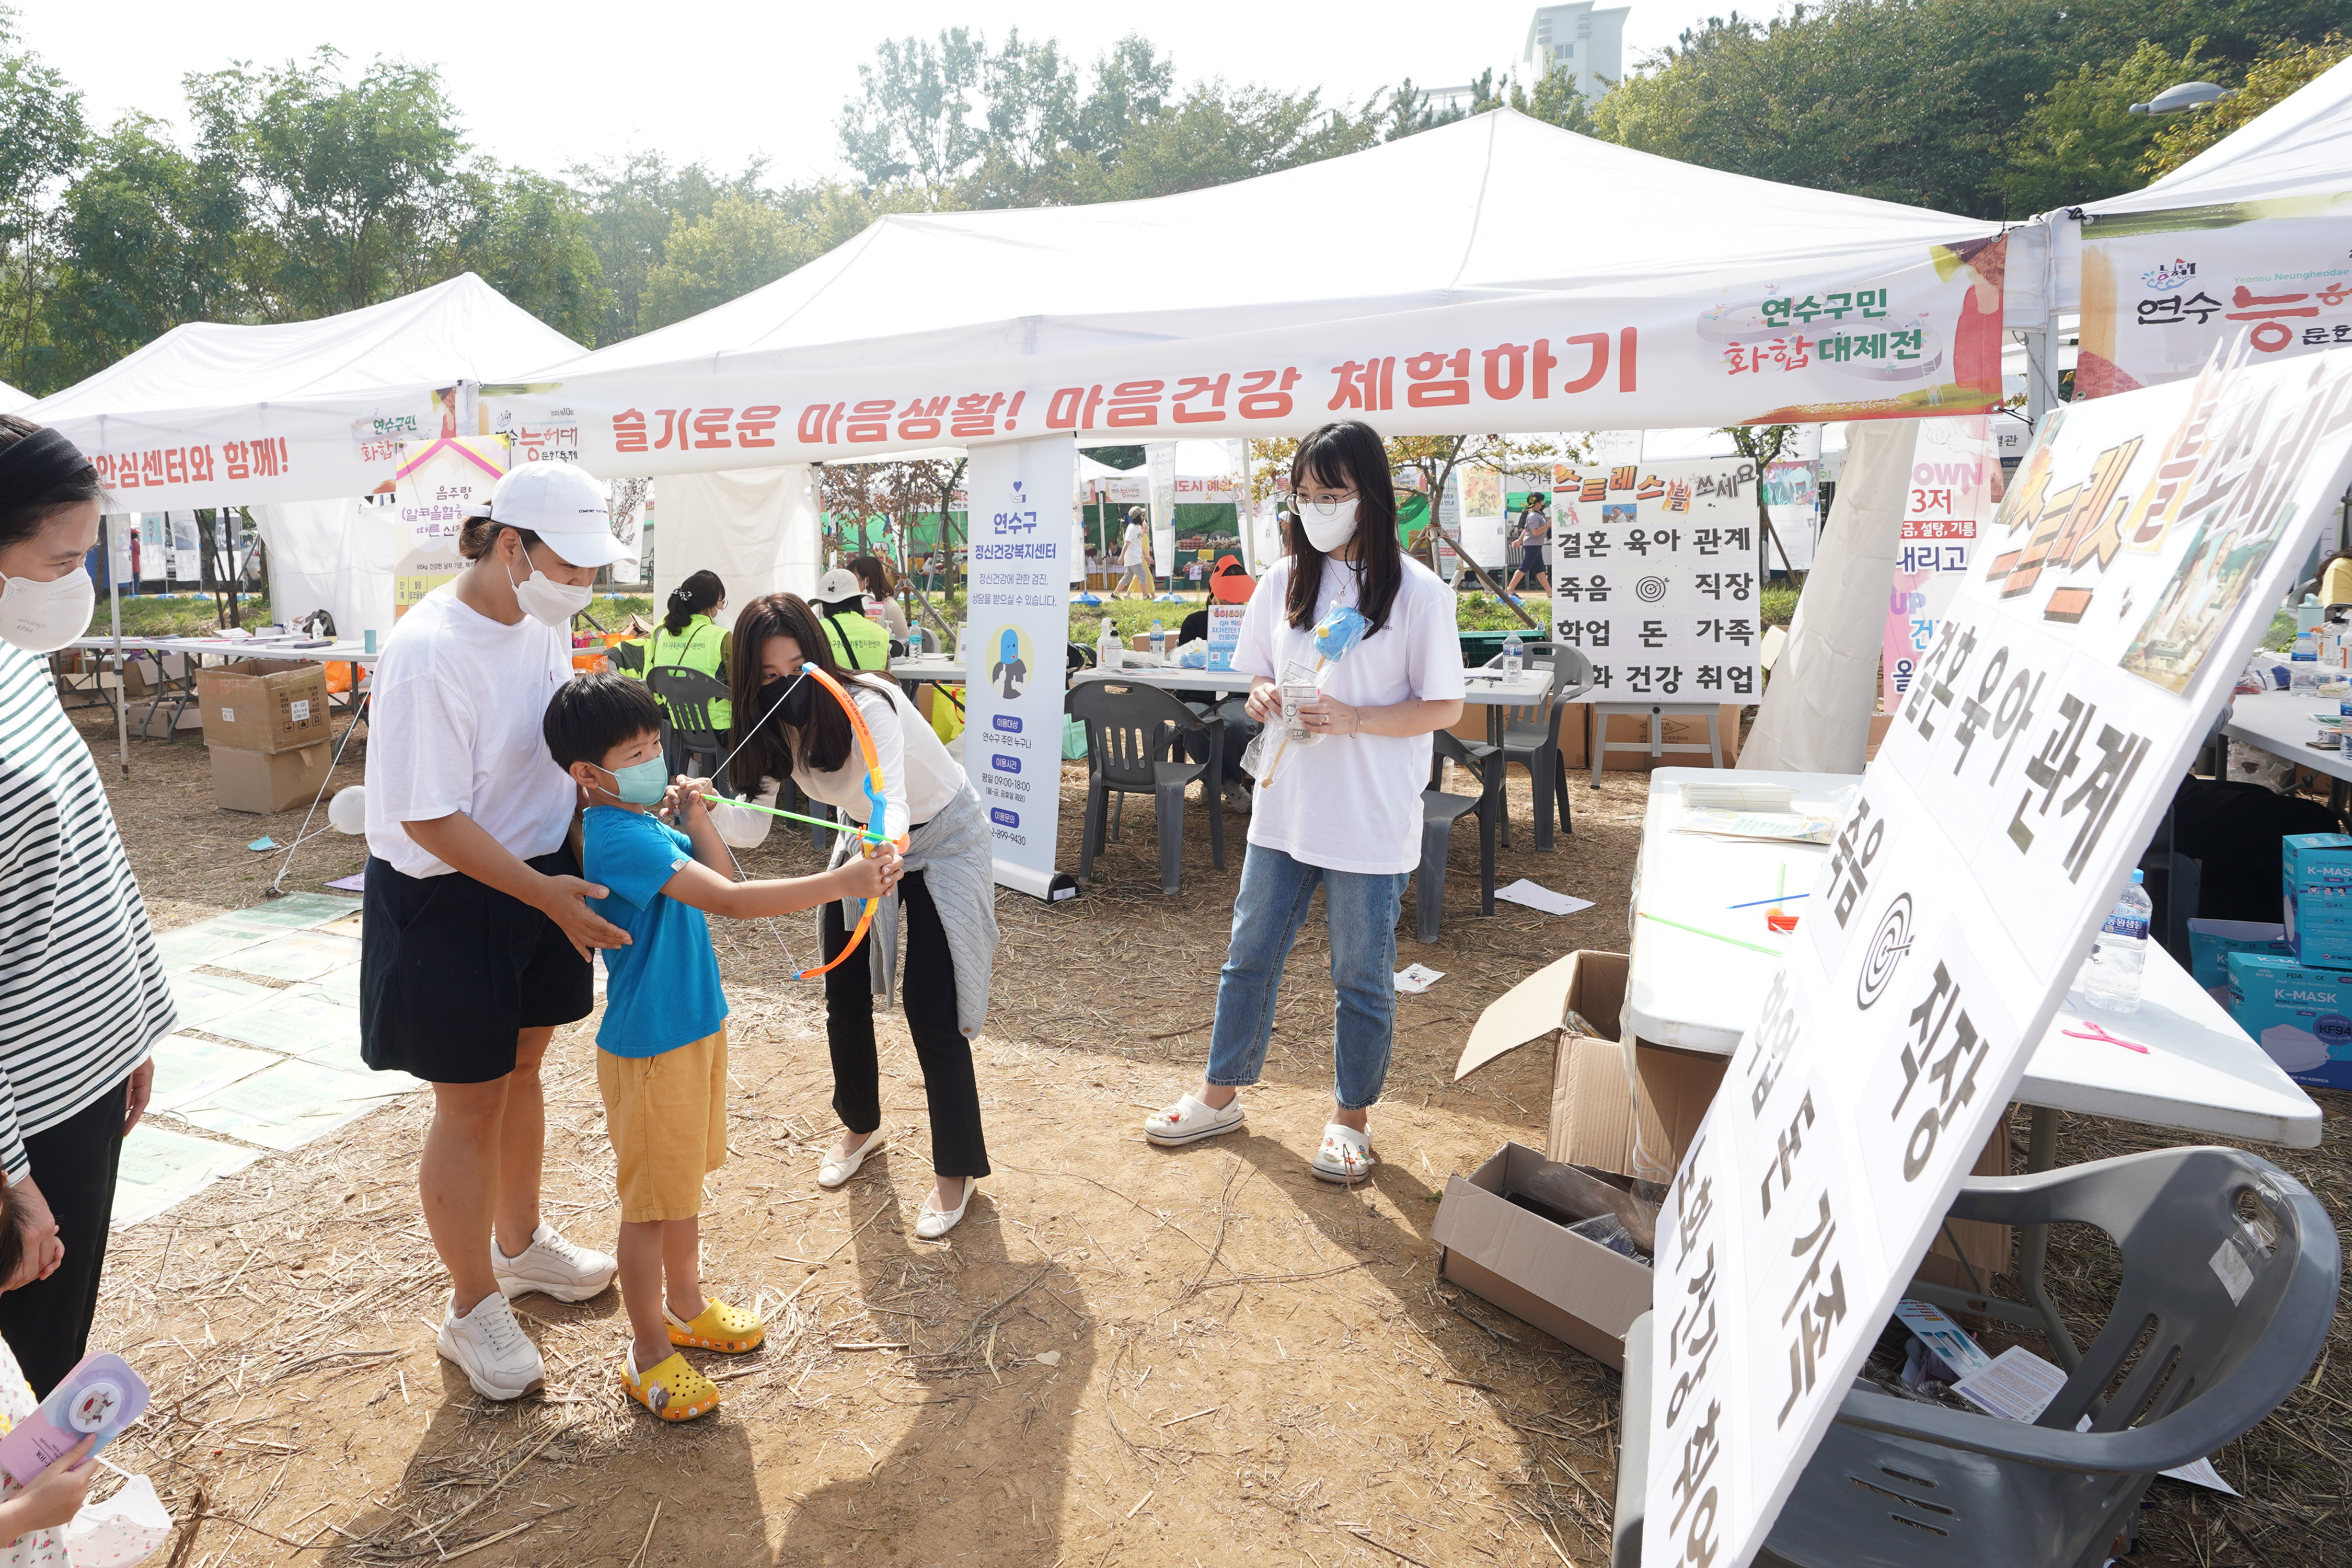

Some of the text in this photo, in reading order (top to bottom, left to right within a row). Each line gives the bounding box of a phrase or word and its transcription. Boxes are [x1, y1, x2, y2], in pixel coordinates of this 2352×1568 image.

[2234, 268, 2349, 284] Yeonsu Neungheodae
[1761, 288, 1887, 328] 연수구민
[2138, 291, 2222, 325] 연수
[613, 326, 1638, 453] 슬기로운 마음생활! 마음건강 체험하기
[373, 414, 417, 435] 연수구민
[519, 426, 578, 462] 능허대
[84, 436, 289, 490] 안심센터와 함께!
[436, 486, 472, 501] 음주량
[1174, 480, 1202, 492] 도시
[1553, 463, 1758, 514] 스트레스를 쏘세요
[1911, 489, 1952, 515] 3저
[417, 524, 440, 537] 따른
[994, 512, 1037, 535] 연수구
[1921, 522, 1948, 537] 설탕,
[1951, 522, 1976, 537] 기름
[975, 543, 1056, 560] 정신건강복지센터
[1558, 527, 1751, 558] 결혼 육아 관계
[1896, 546, 1968, 572] 내리고
[979, 573, 1048, 586] 정신건강에 관한 검진,
[1557, 572, 1754, 602] 죽음 직장
[972, 593, 1057, 607] 상담을 받으실 수 있습니다.
[1890, 591, 1926, 615] UP
[15, 624, 34, 633] KF94
[17, 617, 47, 629] airdays
[1557, 619, 1755, 648] 학업 돈 가족
[1626, 665, 1683, 694] 건강
[1697, 665, 1753, 694] 취업
[997, 718, 1019, 730] 이용대상
[983, 732, 1032, 750] 연수구 주민 누구나
[1905, 620, 2153, 884] 결혼 육아 관계
[996, 757, 1017, 770] 이용시간
[982, 773, 1031, 792] 평일 09:00-18:00
[1000, 790, 1013, 801] 공휴일
[1014, 792, 1025, 803] 제외)
[995, 810, 1015, 824] 이용문의
[2308, 866, 2352, 876] K-MAS
[2107, 916, 2142, 929] 동원샘물
[1826, 795, 1990, 1182] 죽음 직장
[2275, 989, 2337, 1003] K-MASK
[2319, 1024, 2352, 1036] KF94
[1746, 969, 1848, 1433] 학업 돈 가족
[1666, 1241, 1719, 1428] 건강
